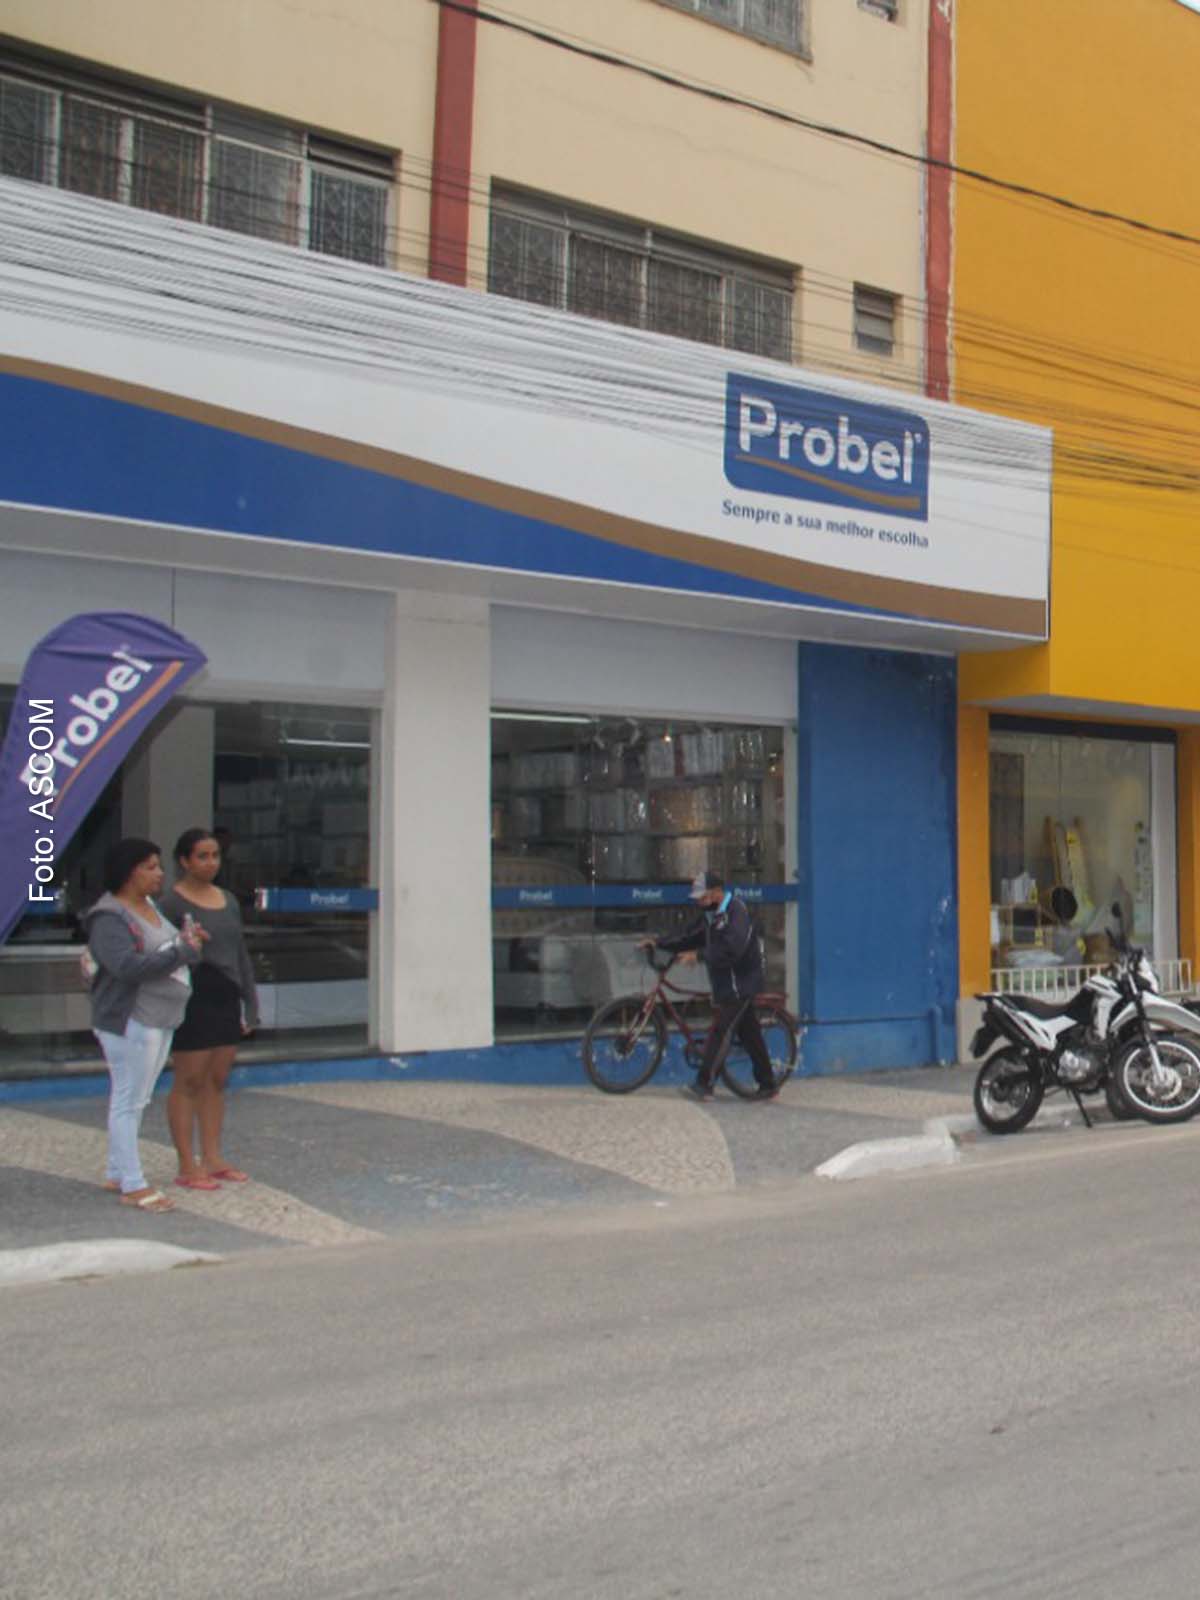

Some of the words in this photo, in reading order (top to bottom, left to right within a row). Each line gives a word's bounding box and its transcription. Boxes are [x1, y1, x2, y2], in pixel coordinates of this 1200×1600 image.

[738, 393, 914, 484] Probel
[721, 499, 781, 525] Sempre
[784, 512, 794, 525] a
[797, 514, 822, 531] sua
[826, 519, 875, 540] melhor
[878, 529, 930, 548] escolha
